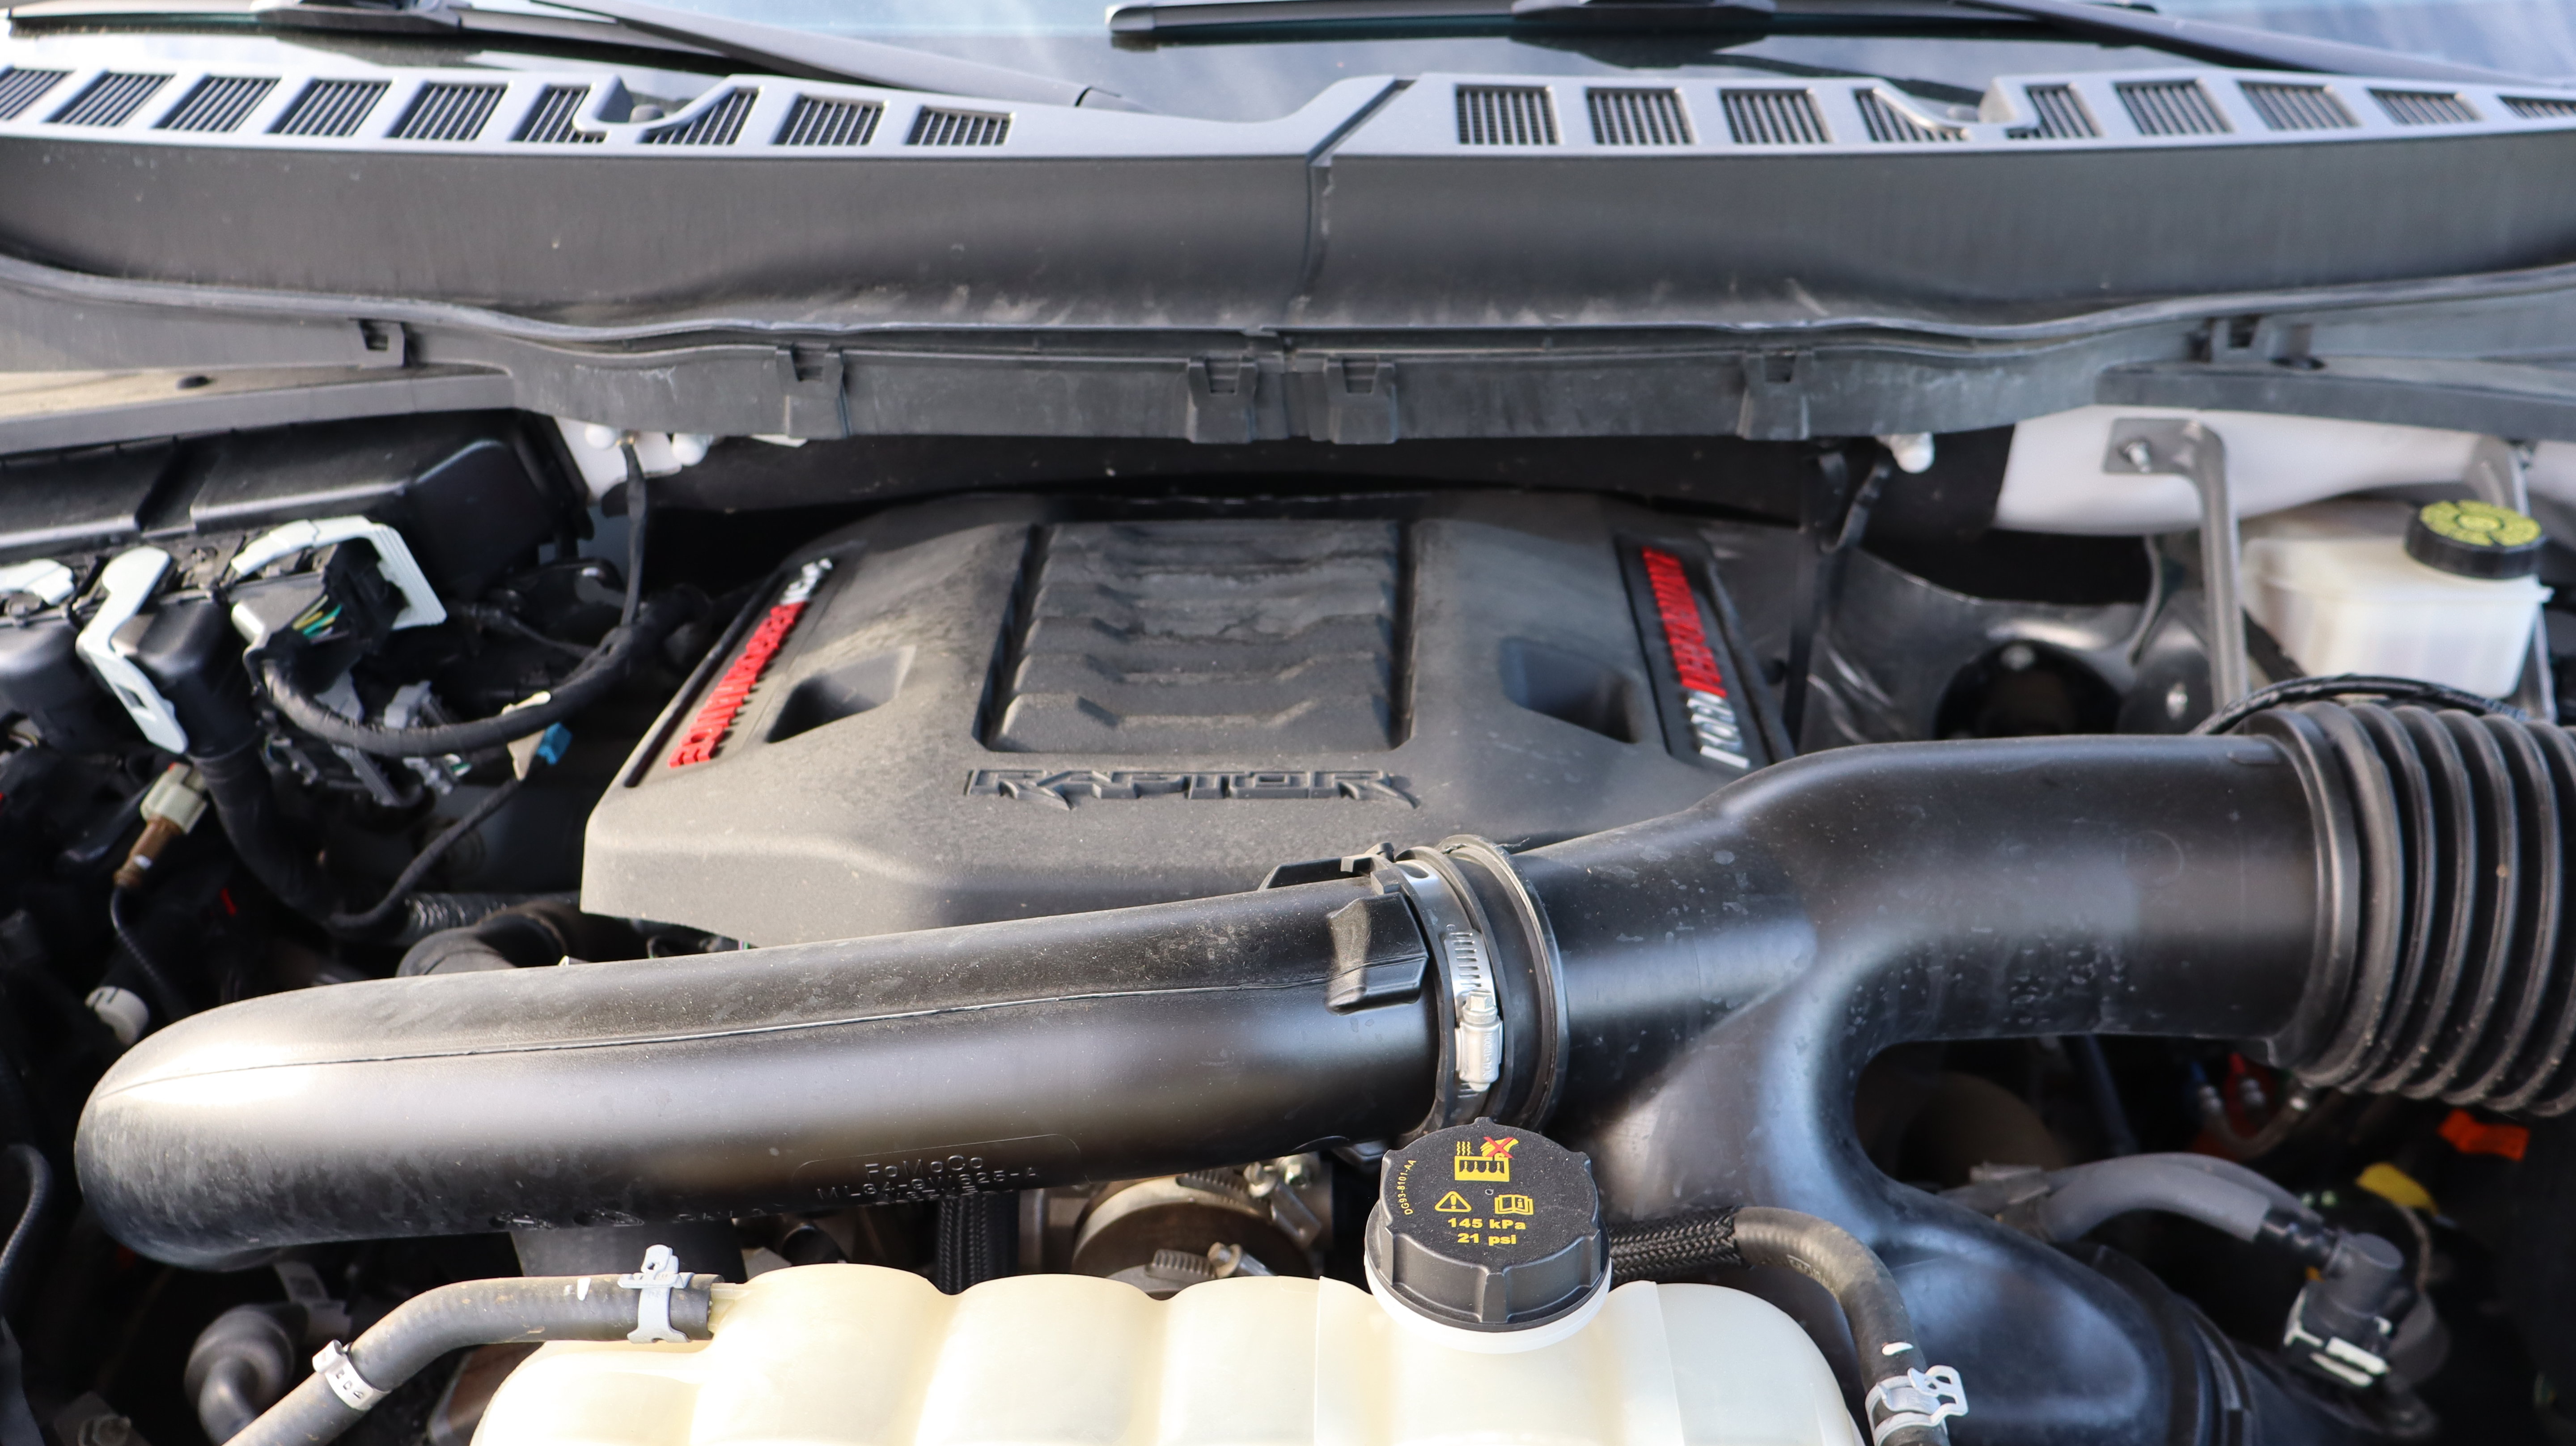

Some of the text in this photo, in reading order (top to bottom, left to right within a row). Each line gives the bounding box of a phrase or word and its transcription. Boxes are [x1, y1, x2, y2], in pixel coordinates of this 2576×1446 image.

[964, 769, 1419, 810] RAPTOR
[865, 1154, 983, 1179] FoMoCo
[1396, 1159, 1417, 1215] DG93-8101-AA
[1448, 1217, 1526, 1230] 145 kPa
[1457, 1233, 1517, 1246] 21 psi
